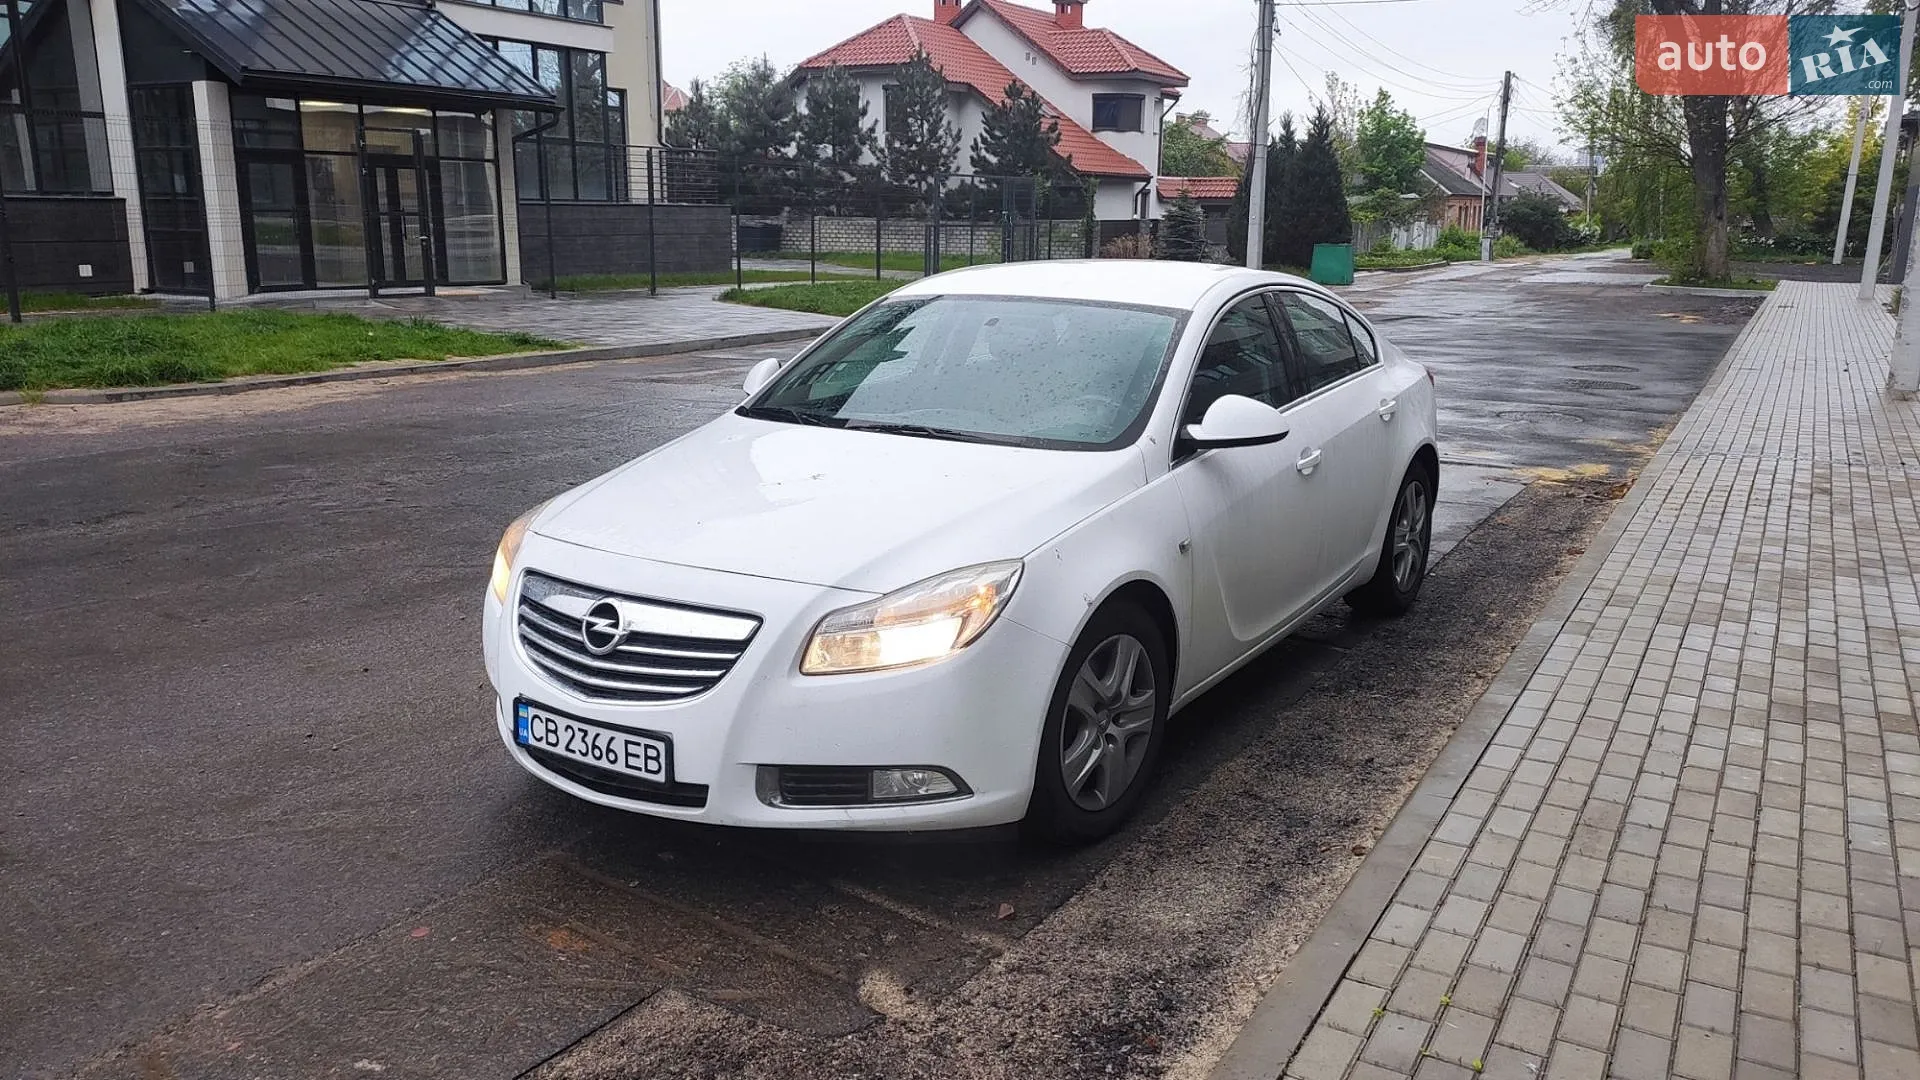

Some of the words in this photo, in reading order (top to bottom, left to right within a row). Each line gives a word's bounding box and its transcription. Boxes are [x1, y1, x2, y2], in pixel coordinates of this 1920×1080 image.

[518, 727, 528, 737] UA
[530, 713, 560, 748] CB
[564, 724, 618, 765] 2366
[624, 739, 662, 775] EB
